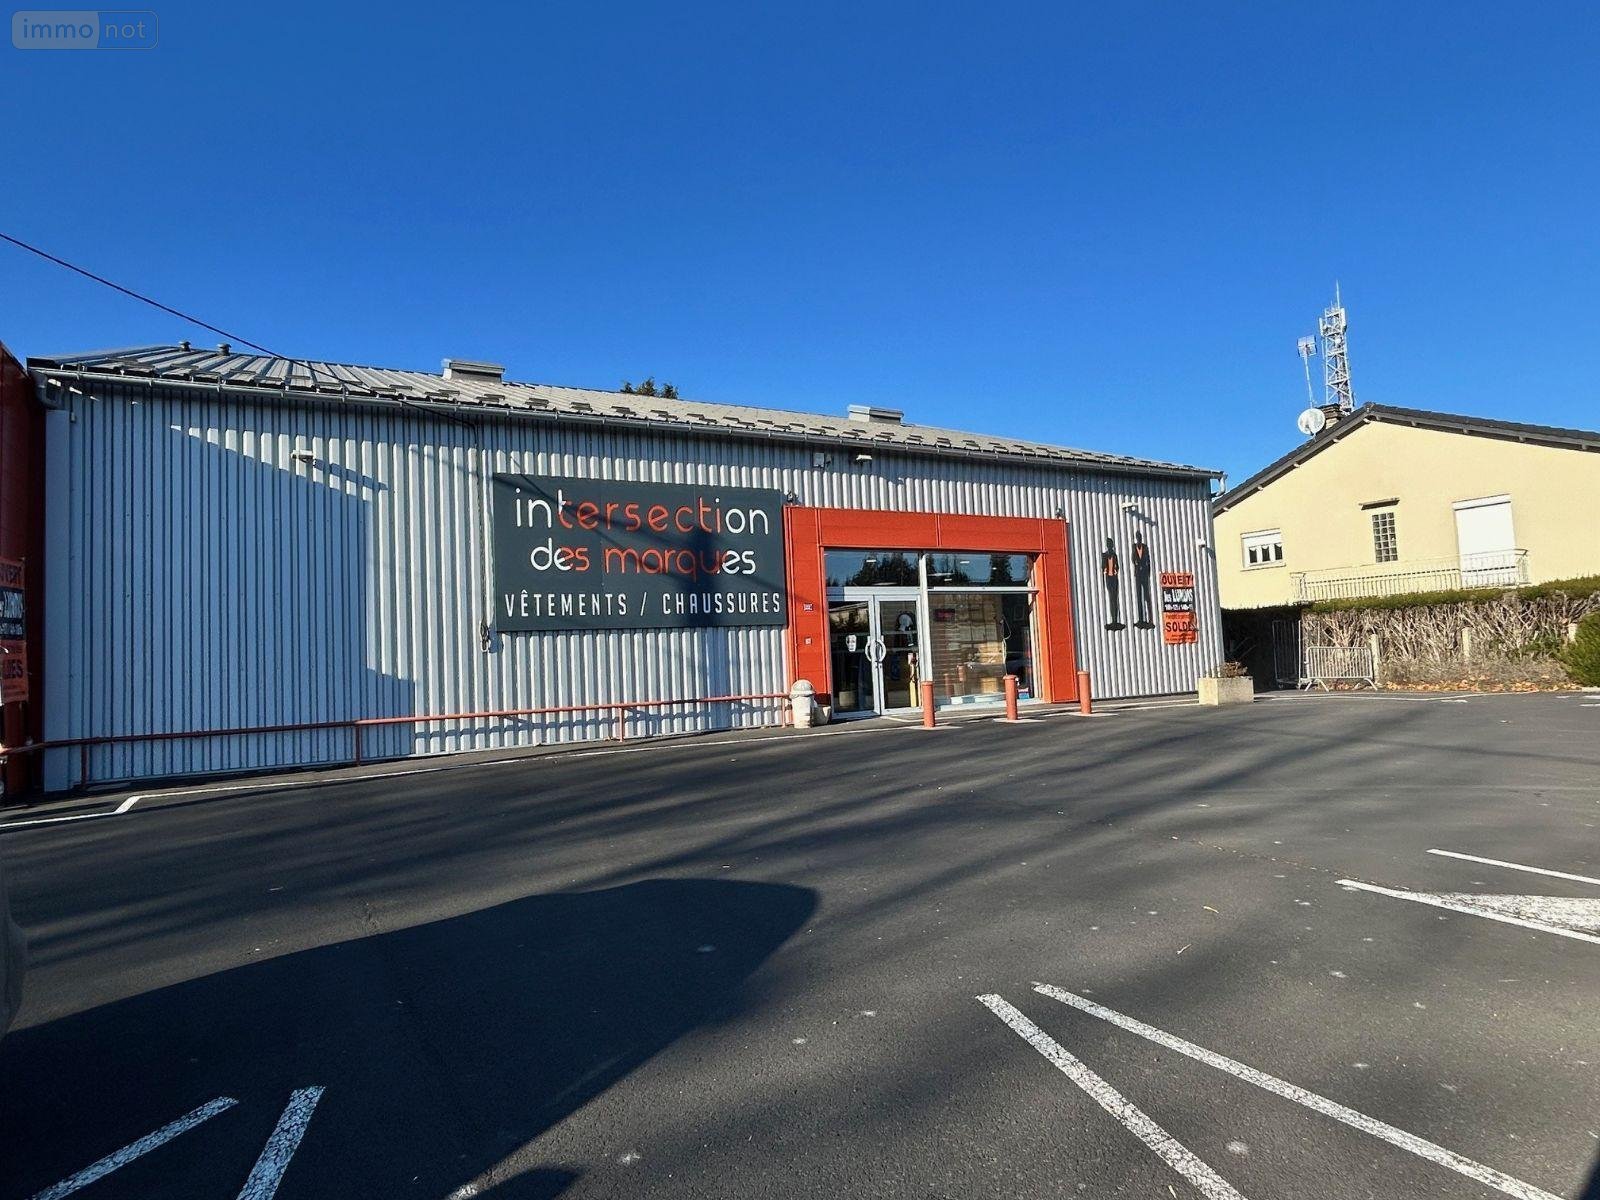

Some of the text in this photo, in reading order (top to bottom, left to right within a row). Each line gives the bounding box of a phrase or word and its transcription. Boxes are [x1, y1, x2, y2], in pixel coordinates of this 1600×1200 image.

[514, 487, 770, 535] intersection
[530, 537, 757, 583] des marques
[504, 590, 627, 617] VÊTEMENTS
[662, 591, 781, 615] CHAUSSURES
[1165, 621, 1196, 632] SOLDE
